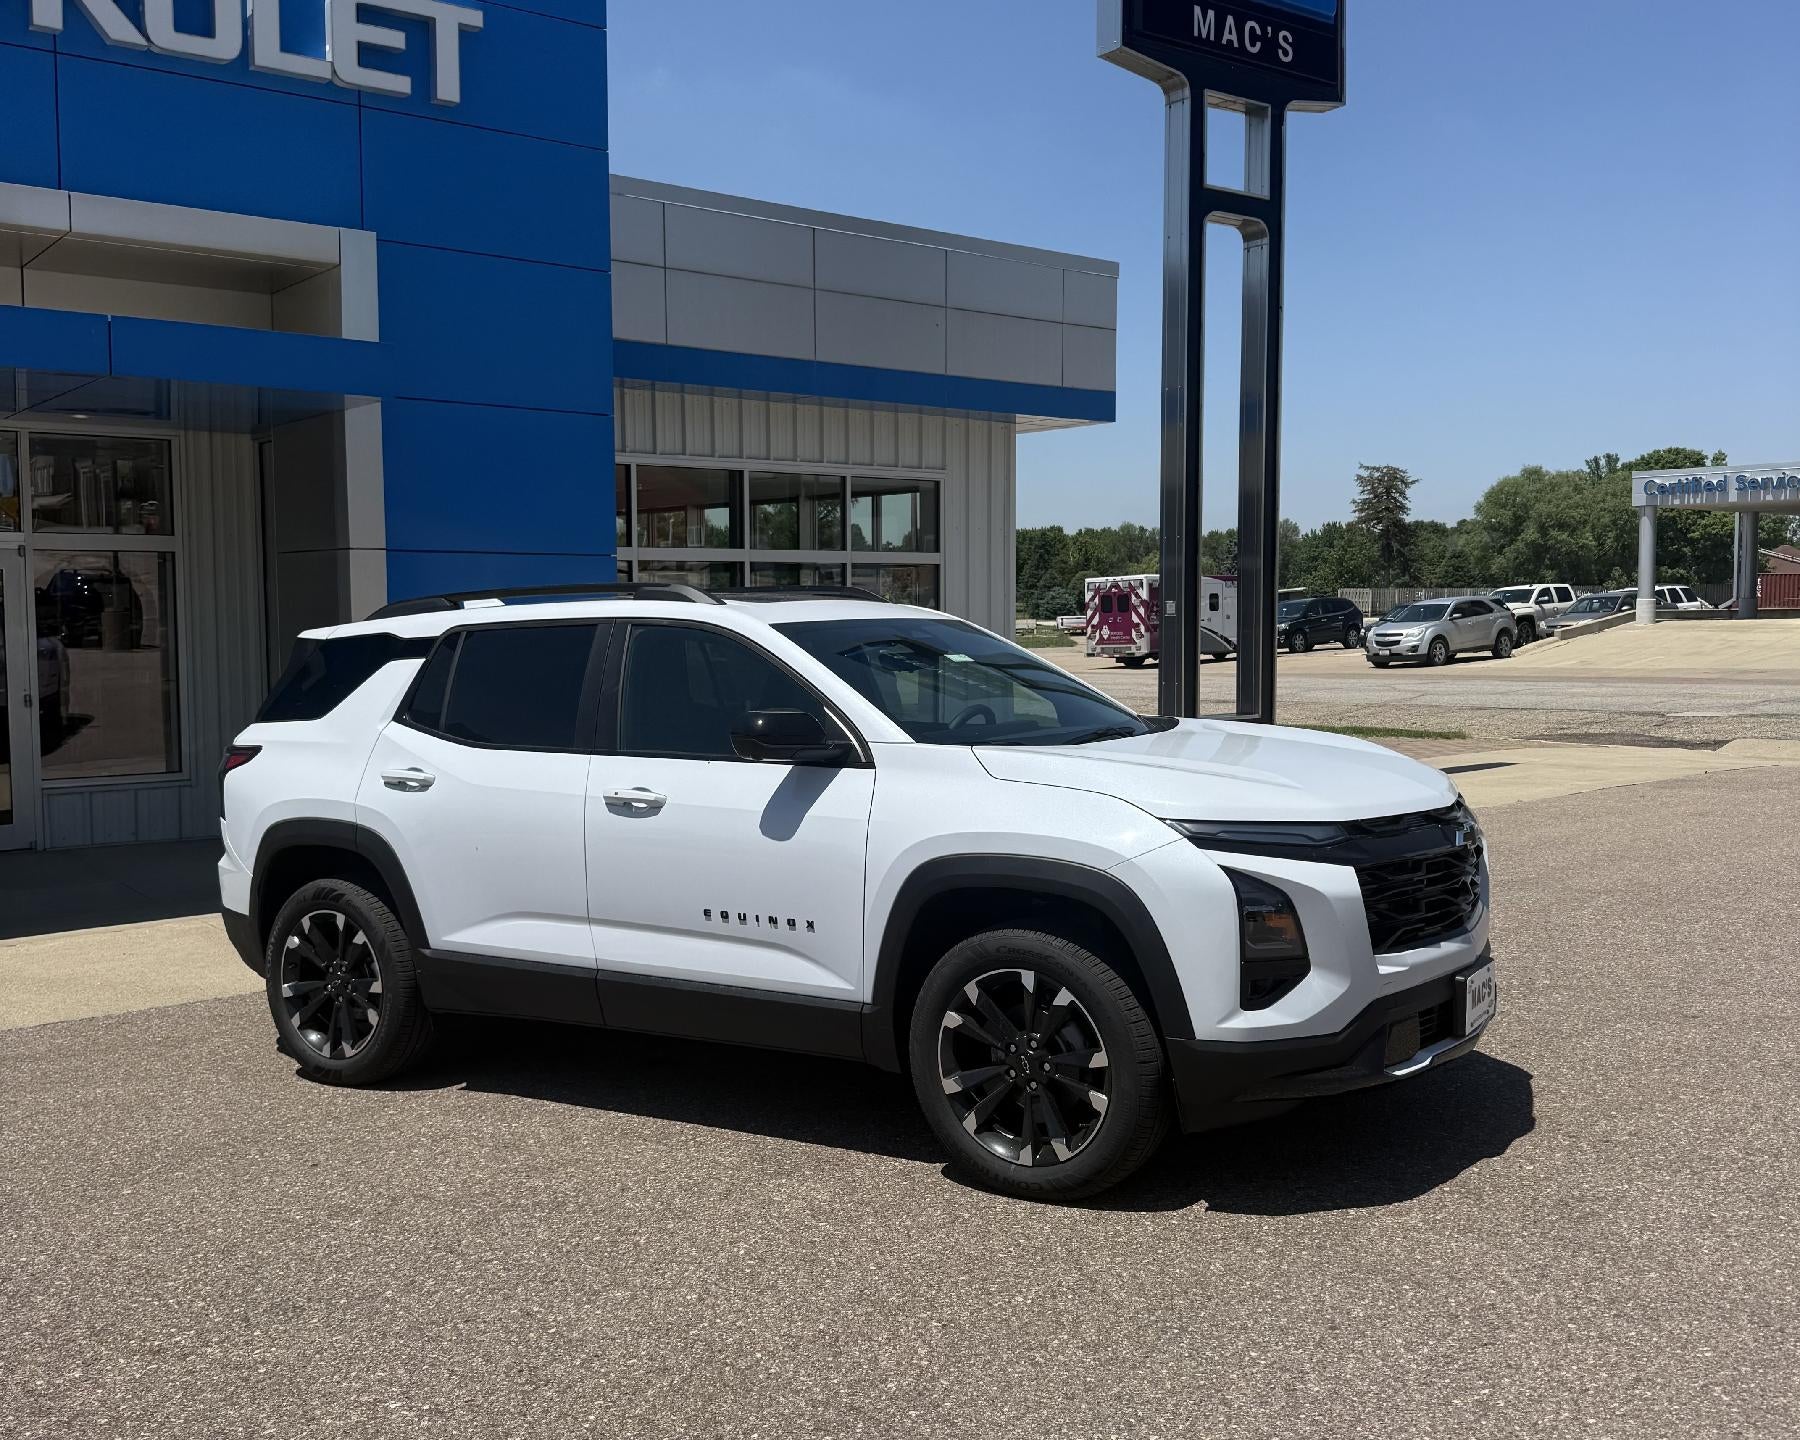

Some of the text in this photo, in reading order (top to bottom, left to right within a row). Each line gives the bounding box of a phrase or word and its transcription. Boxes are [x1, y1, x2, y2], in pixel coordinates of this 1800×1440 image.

[1193, 4, 1294, 63] MAC'S
[1643, 472, 1800, 496] Certified Servic
[703, 908, 815, 931] EQUINOX
[1471, 976, 1493, 1010] MAC'S
